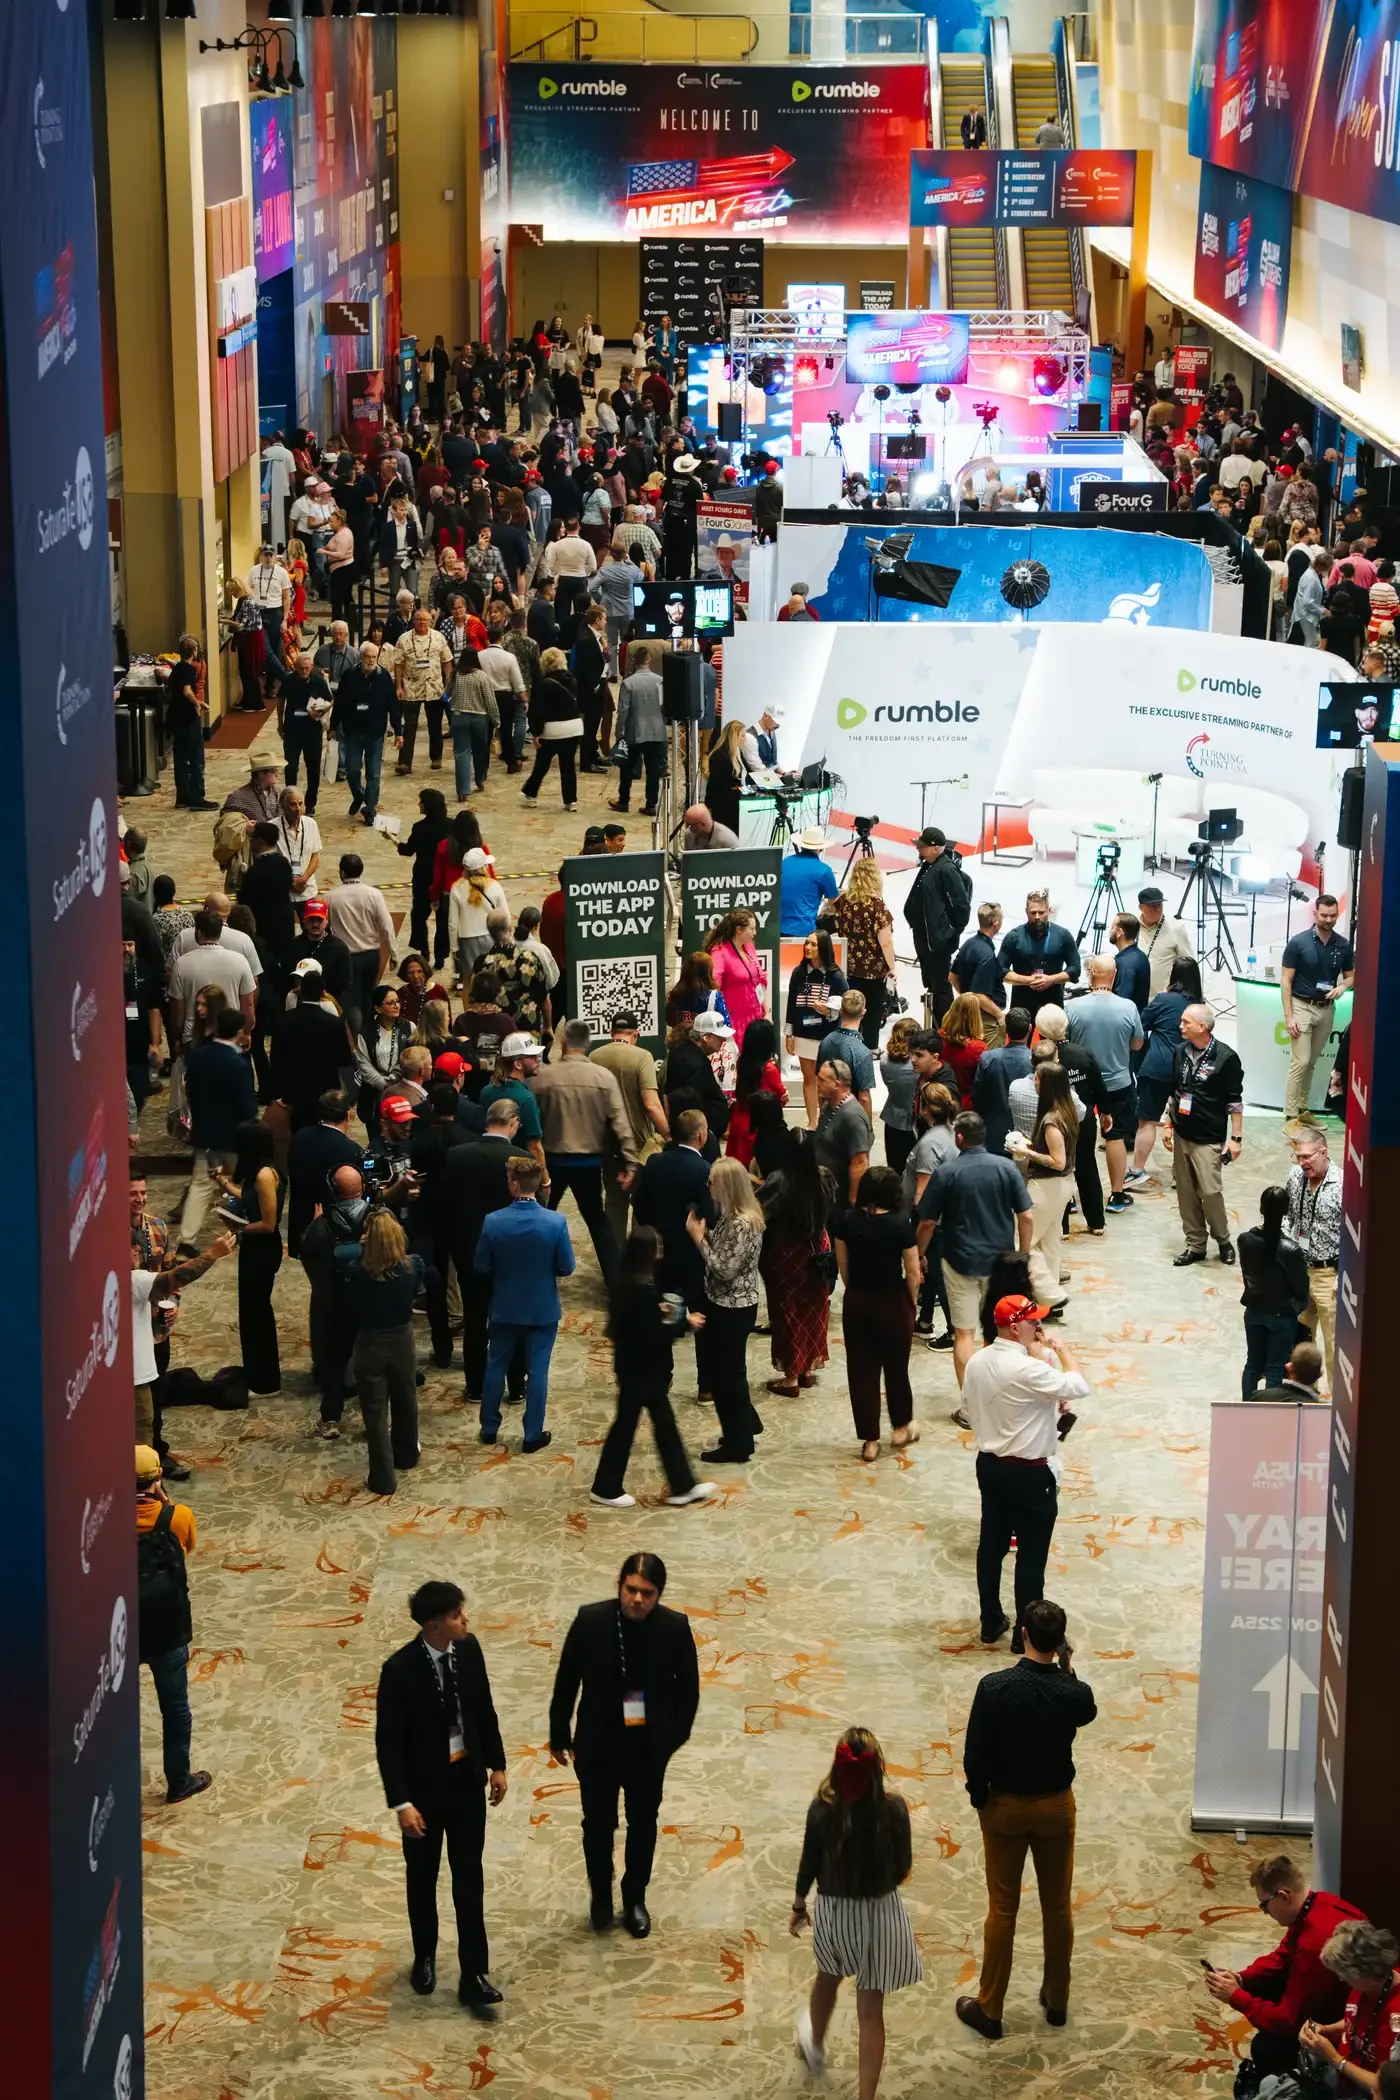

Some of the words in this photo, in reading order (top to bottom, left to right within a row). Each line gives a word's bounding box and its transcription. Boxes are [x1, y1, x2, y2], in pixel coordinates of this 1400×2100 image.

[561, 79, 627, 96] rumble
[814, 81, 881, 98] rumble
[660, 108, 731, 131] WELCOME
[742, 109, 759, 131] TO
[623, 198, 717, 232] AMERICA
[717, 188, 794, 225] Fest
[732, 215, 788, 232] 2025
[1174, 388, 1187, 396] GET
[1200, 677, 1262, 699] rumble
[874, 700, 980, 723] rumble
[1129, 705, 1148, 715] THE
[1150, 707, 1200, 721] EXCLUSIVE
[1202, 713, 1250, 730] STREAMING
[1250, 721, 1284, 739] PARTNER
[1284, 730, 1293, 740] OF
[1200, 748, 1244, 765] TURNING
[1200, 757, 1229, 771] POINT
[1229, 763, 1248, 775] USA
[568, 878, 661, 897] DOWNLOAD
[687, 873, 778, 891] DOWNLOAD
[576, 899, 613, 917] THE
[616, 896, 655, 914] APP
[694, 893, 730, 909] THE
[734, 891, 772, 907] APP
[577, 916, 654, 939] TODAY
[695, 911, 771, 932] TOY
[1068, 1067, 1080, 1077] the
[1069, 1073, 1087, 1086] point
